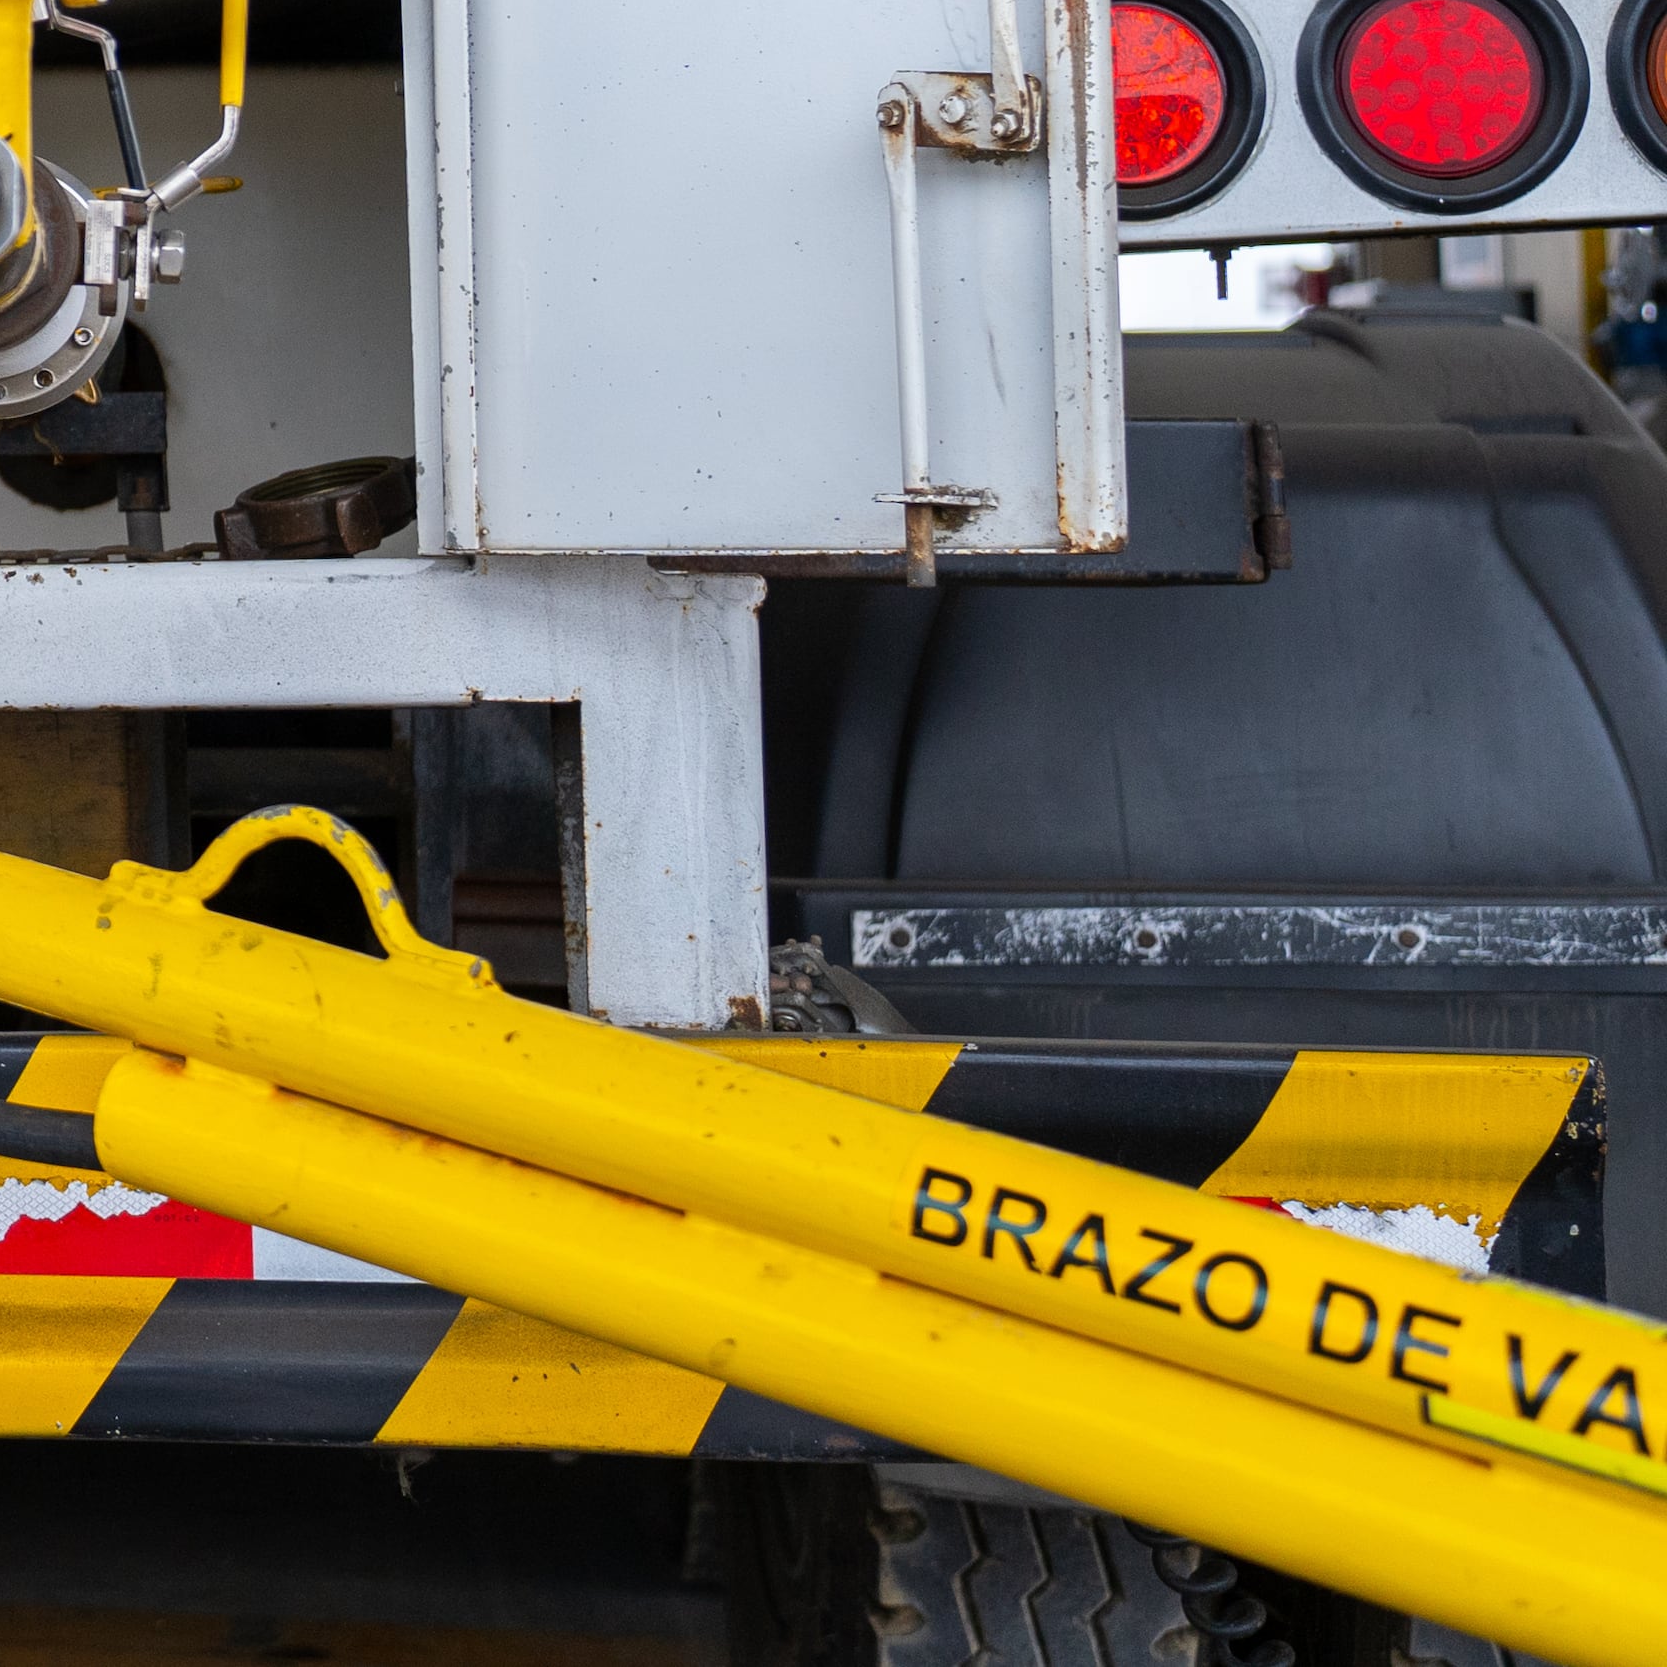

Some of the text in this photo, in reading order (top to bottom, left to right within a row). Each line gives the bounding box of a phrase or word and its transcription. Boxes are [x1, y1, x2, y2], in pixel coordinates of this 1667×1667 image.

[910, 1166, 1667, 1459] BRAZO DE VA
